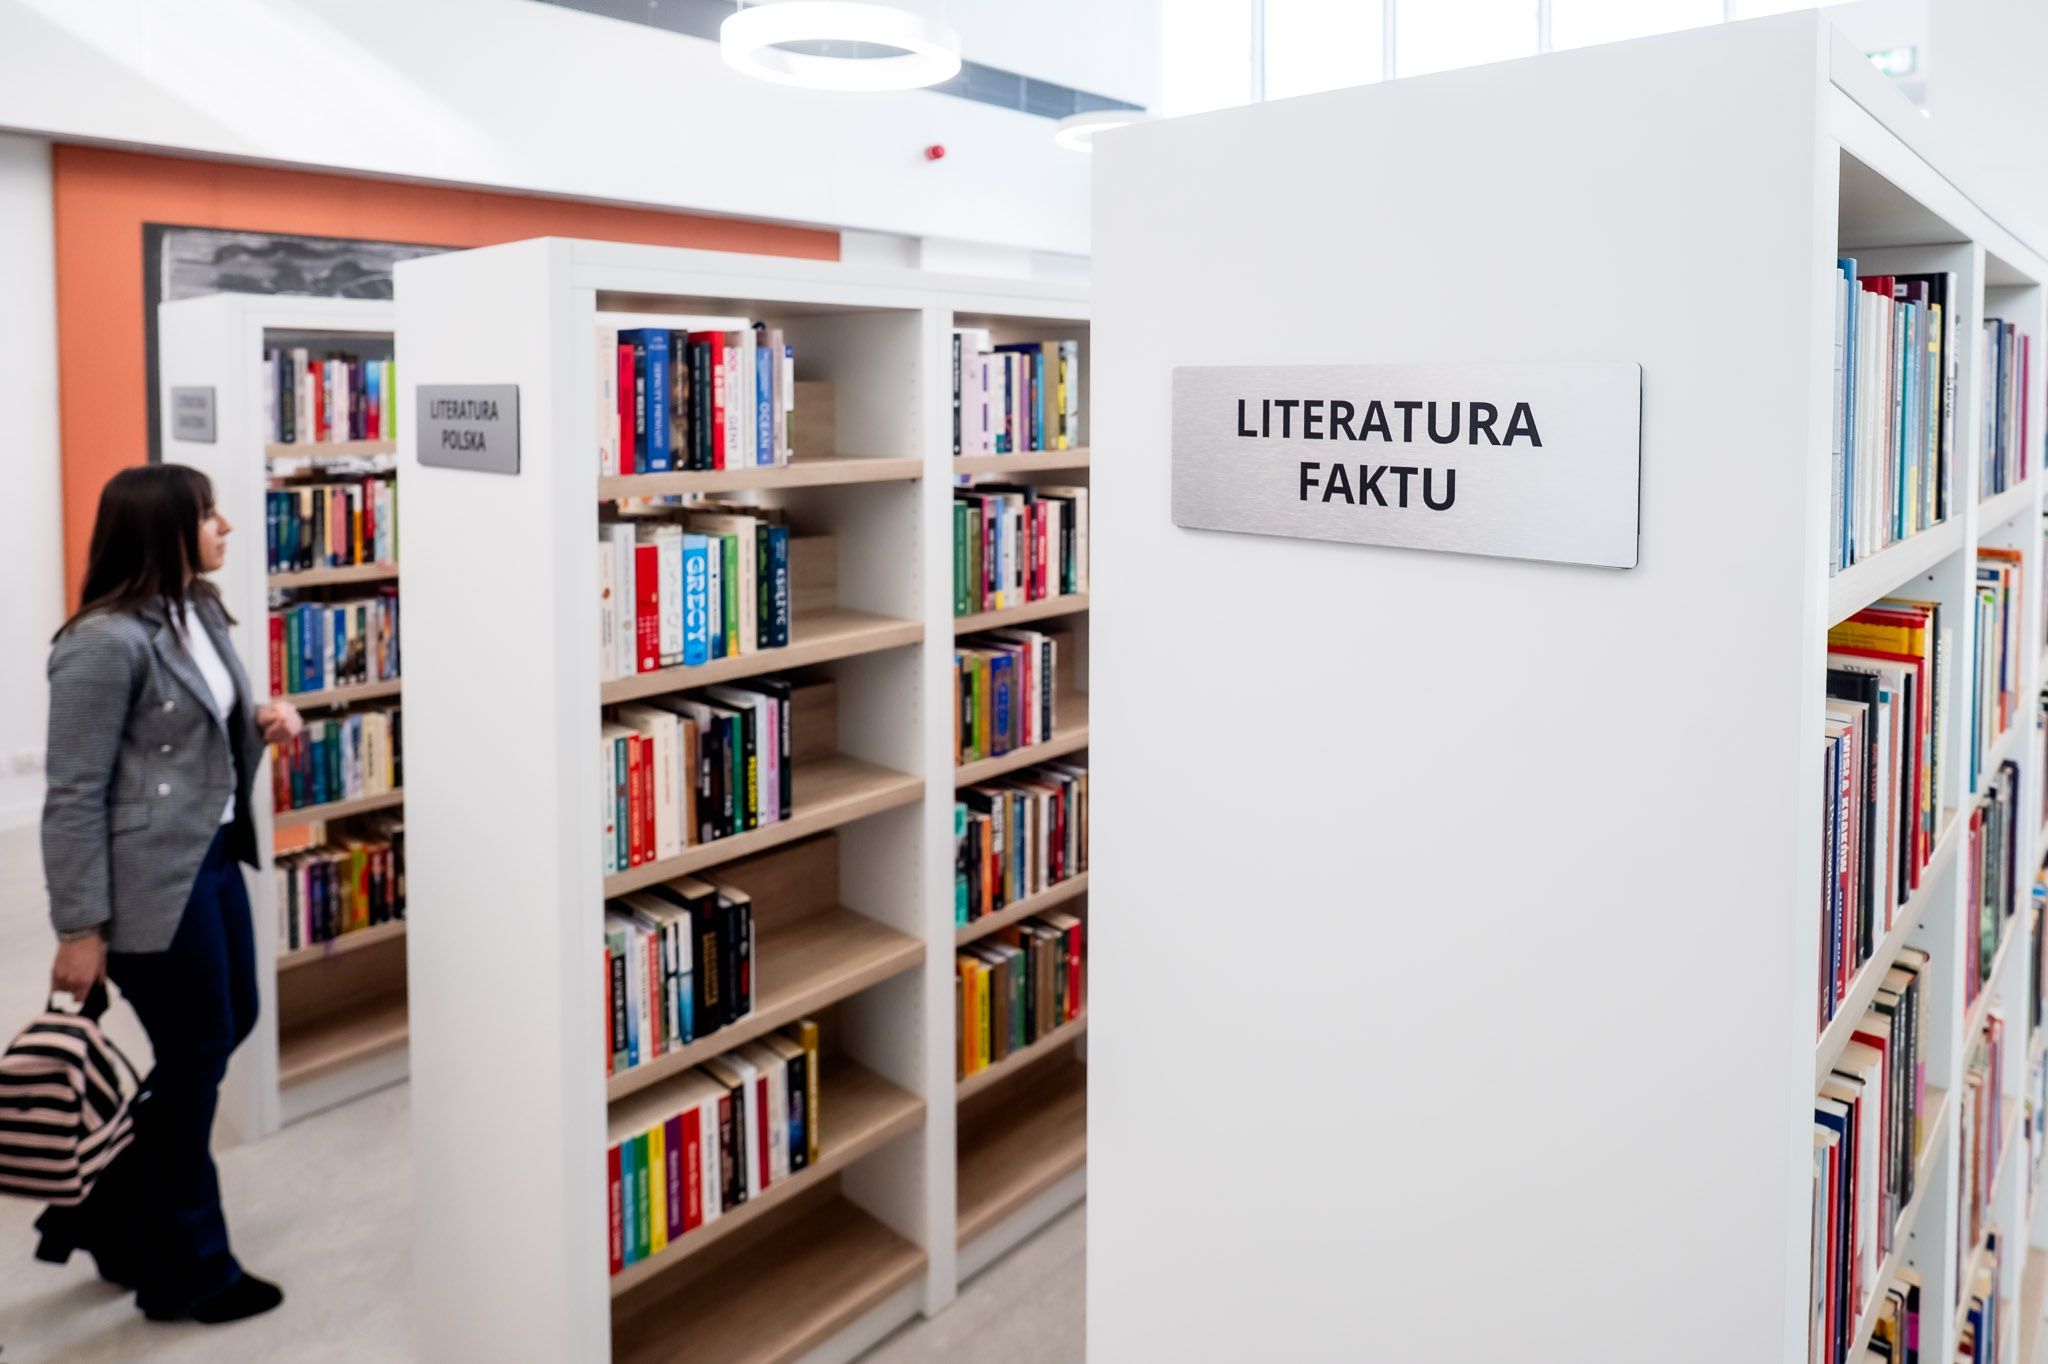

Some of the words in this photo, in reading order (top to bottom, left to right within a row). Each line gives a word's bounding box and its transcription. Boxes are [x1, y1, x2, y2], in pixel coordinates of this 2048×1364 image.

[430, 400, 499, 421] LITERATURA
[1238, 399, 1542, 447] LITERATURA
[442, 430, 486, 452] POLSKA
[1300, 462, 1456, 510] FAKTU
[686, 555, 706, 644] GRECY
[1842, 734, 1851, 791] WISŁA
[1840, 795, 1850, 873] KRAKÓW
